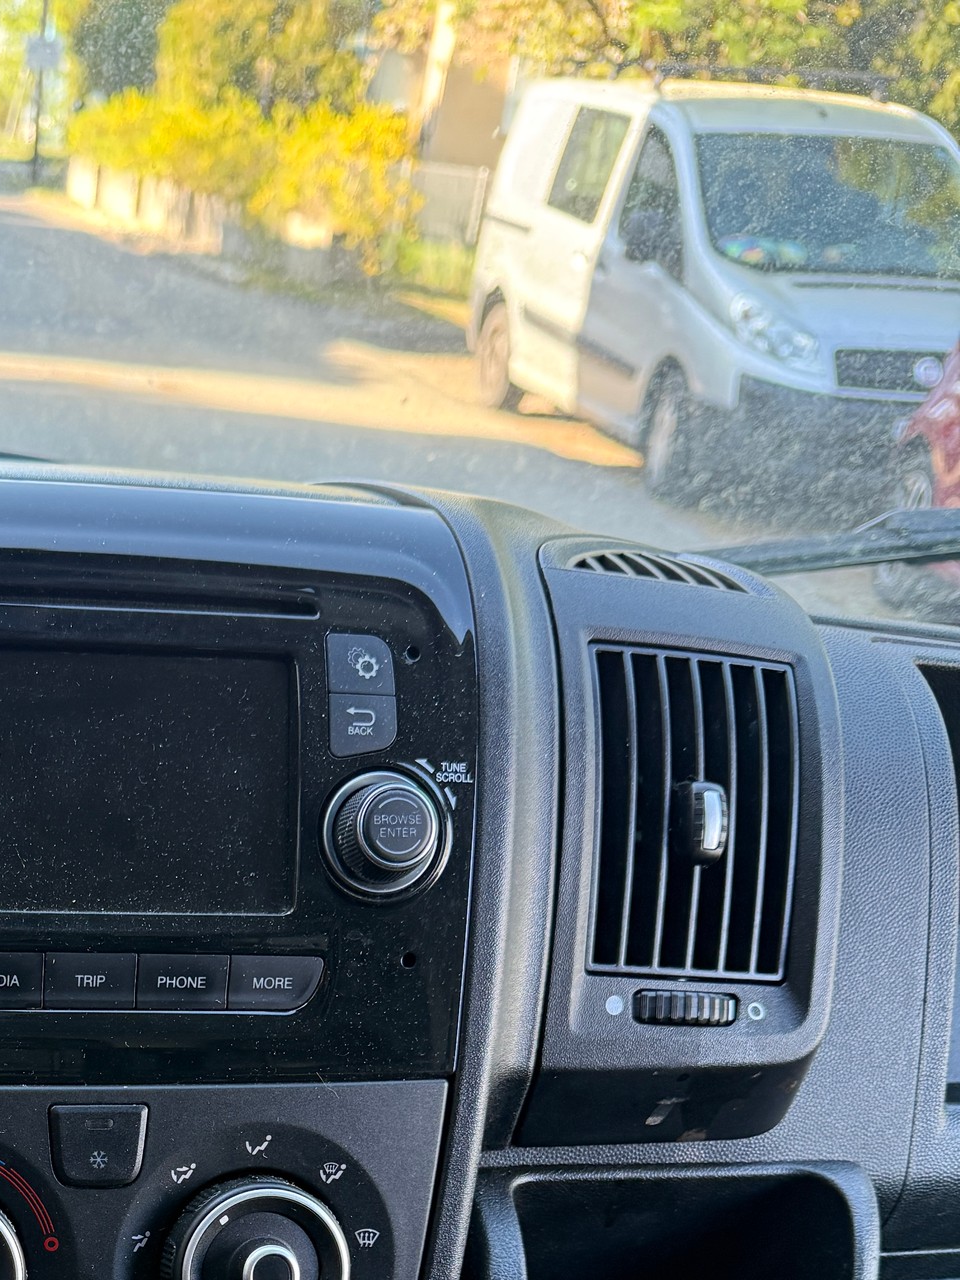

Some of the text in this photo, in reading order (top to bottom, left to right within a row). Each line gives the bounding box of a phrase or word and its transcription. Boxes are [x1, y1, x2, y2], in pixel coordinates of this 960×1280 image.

[347, 726, 373, 735] BACK
[441, 763, 466, 772] TUNE
[436, 773, 473, 783] SCROLL
[373, 814, 423, 825] BROWSE
[379, 828, 417, 838] ENTER
[75, 974, 106, 987] TRIP
[157, 976, 207, 989] PHONE
[252, 977, 294, 990] MORE
